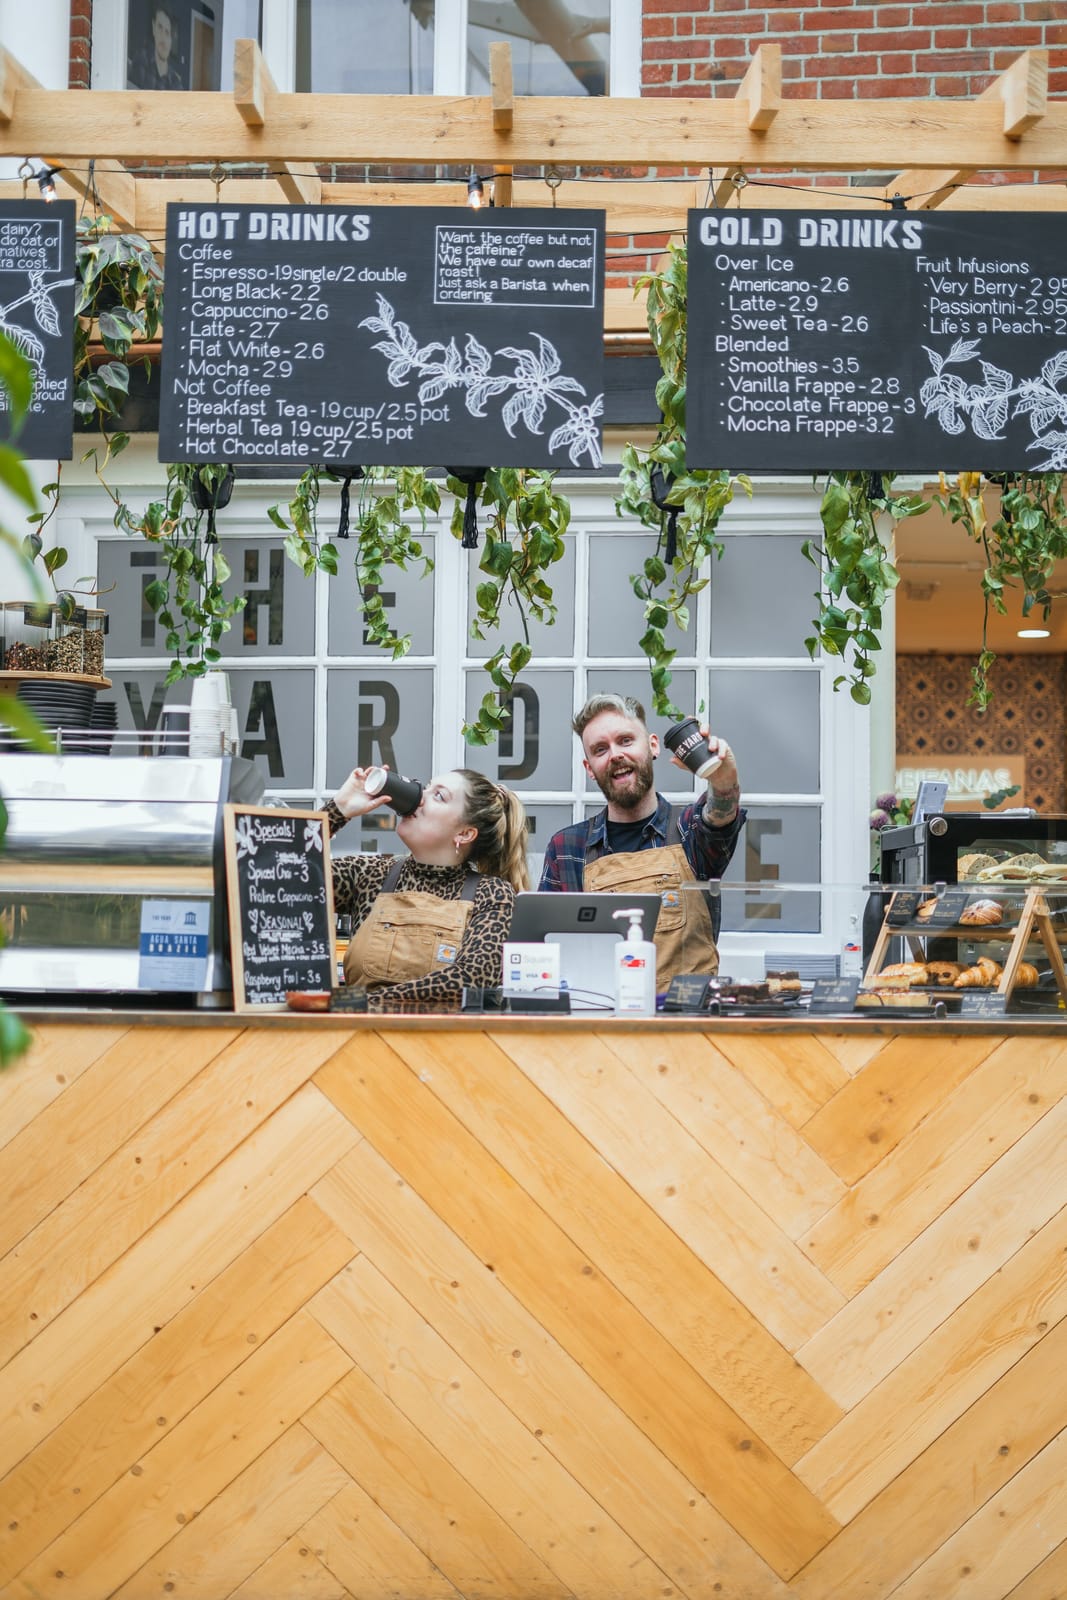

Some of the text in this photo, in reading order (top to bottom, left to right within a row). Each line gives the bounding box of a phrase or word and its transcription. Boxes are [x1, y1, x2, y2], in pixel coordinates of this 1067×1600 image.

[178, 211, 371, 241] HOT DRINKS
[700, 216, 923, 249] COLD DRINKS
[0, 235, 58, 247] do oat or
[439, 231, 593, 246] Want the coffee but not
[178, 244, 233, 260] Coffee
[440, 243, 526, 256] the caffeine?
[438, 254, 593, 269] We have our own decaf
[715, 254, 794, 272] Over Ice
[916, 256, 1030, 274] Fruit Infusions
[358, 267, 407, 282] double
[439, 265, 480, 277] roast!
[191, 282, 232, 301] Long
[438, 277, 590, 292] Just ask a Barista when
[930, 276, 968, 296] Very
[439, 290, 493, 303] ordering
[190, 320, 235, 337] Latte
[730, 314, 787, 331] Sweet
[930, 317, 970, 334] Life's
[977, 322, 988, 334] a
[189, 339, 222, 356] Flat
[716, 335, 789, 352] Blended
[188, 359, 249, 376] Mocha
[728, 356, 818, 374] Smoothies
[174, 378, 271, 396] Not Coffee
[728, 376, 789, 393] Vanilla
[187, 398, 267, 416] Breakfast
[420, 404, 450, 426] pot
[728, 396, 822, 413] Chocolate
[186, 417, 243, 435] Herbal
[251, 418, 283, 436] Tea
[386, 425, 414, 445] pot
[727, 415, 791, 432] Mocha
[186, 437, 216, 454] Hot
